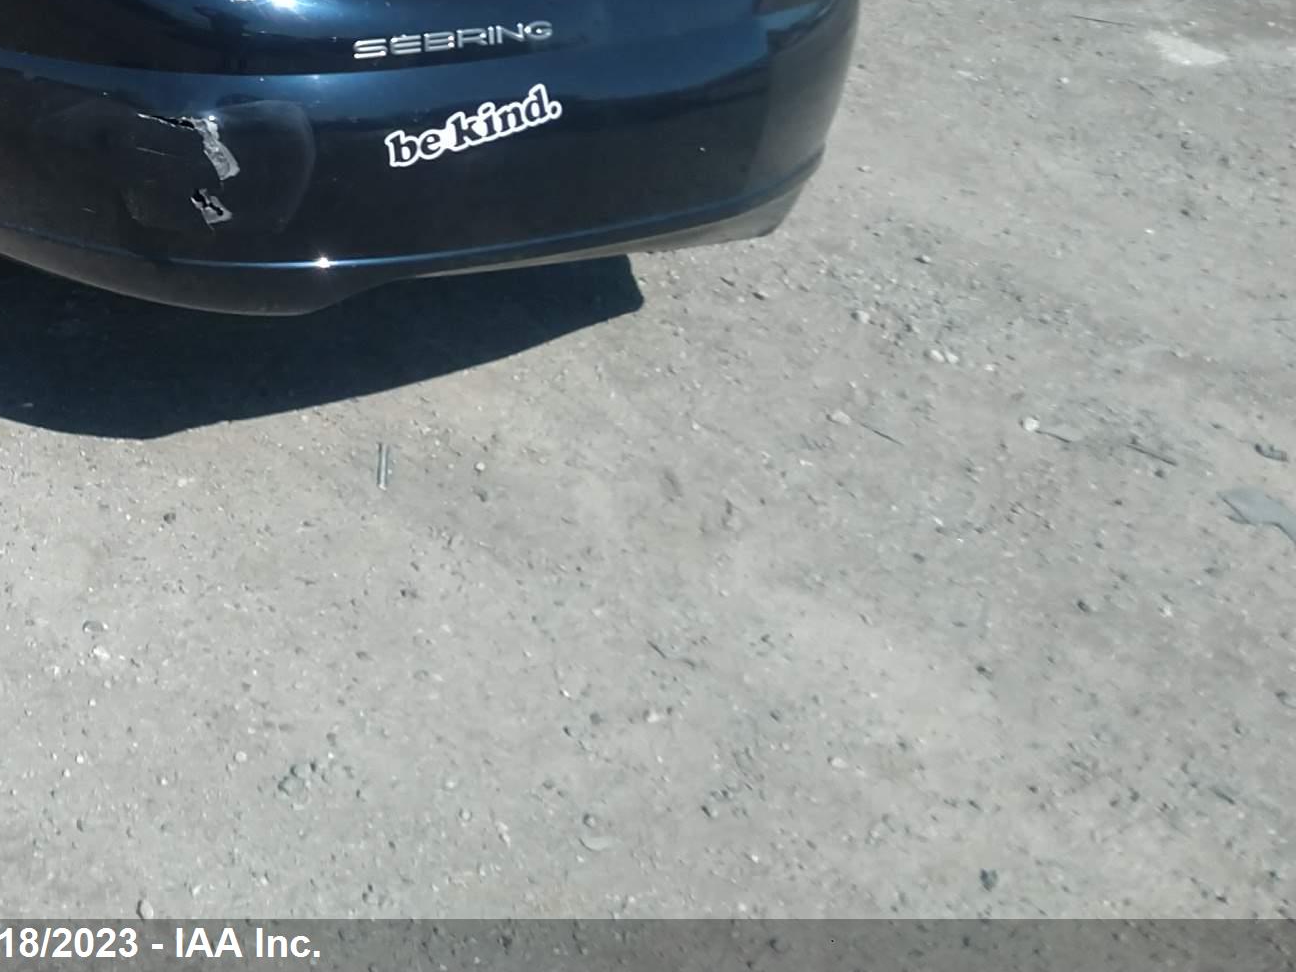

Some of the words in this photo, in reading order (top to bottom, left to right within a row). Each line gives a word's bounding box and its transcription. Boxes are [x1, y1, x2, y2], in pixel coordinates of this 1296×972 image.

[354, 21, 552, 59] SEBRING
[387, 131, 442, 165] be
[448, 85, 561, 150] kind.
